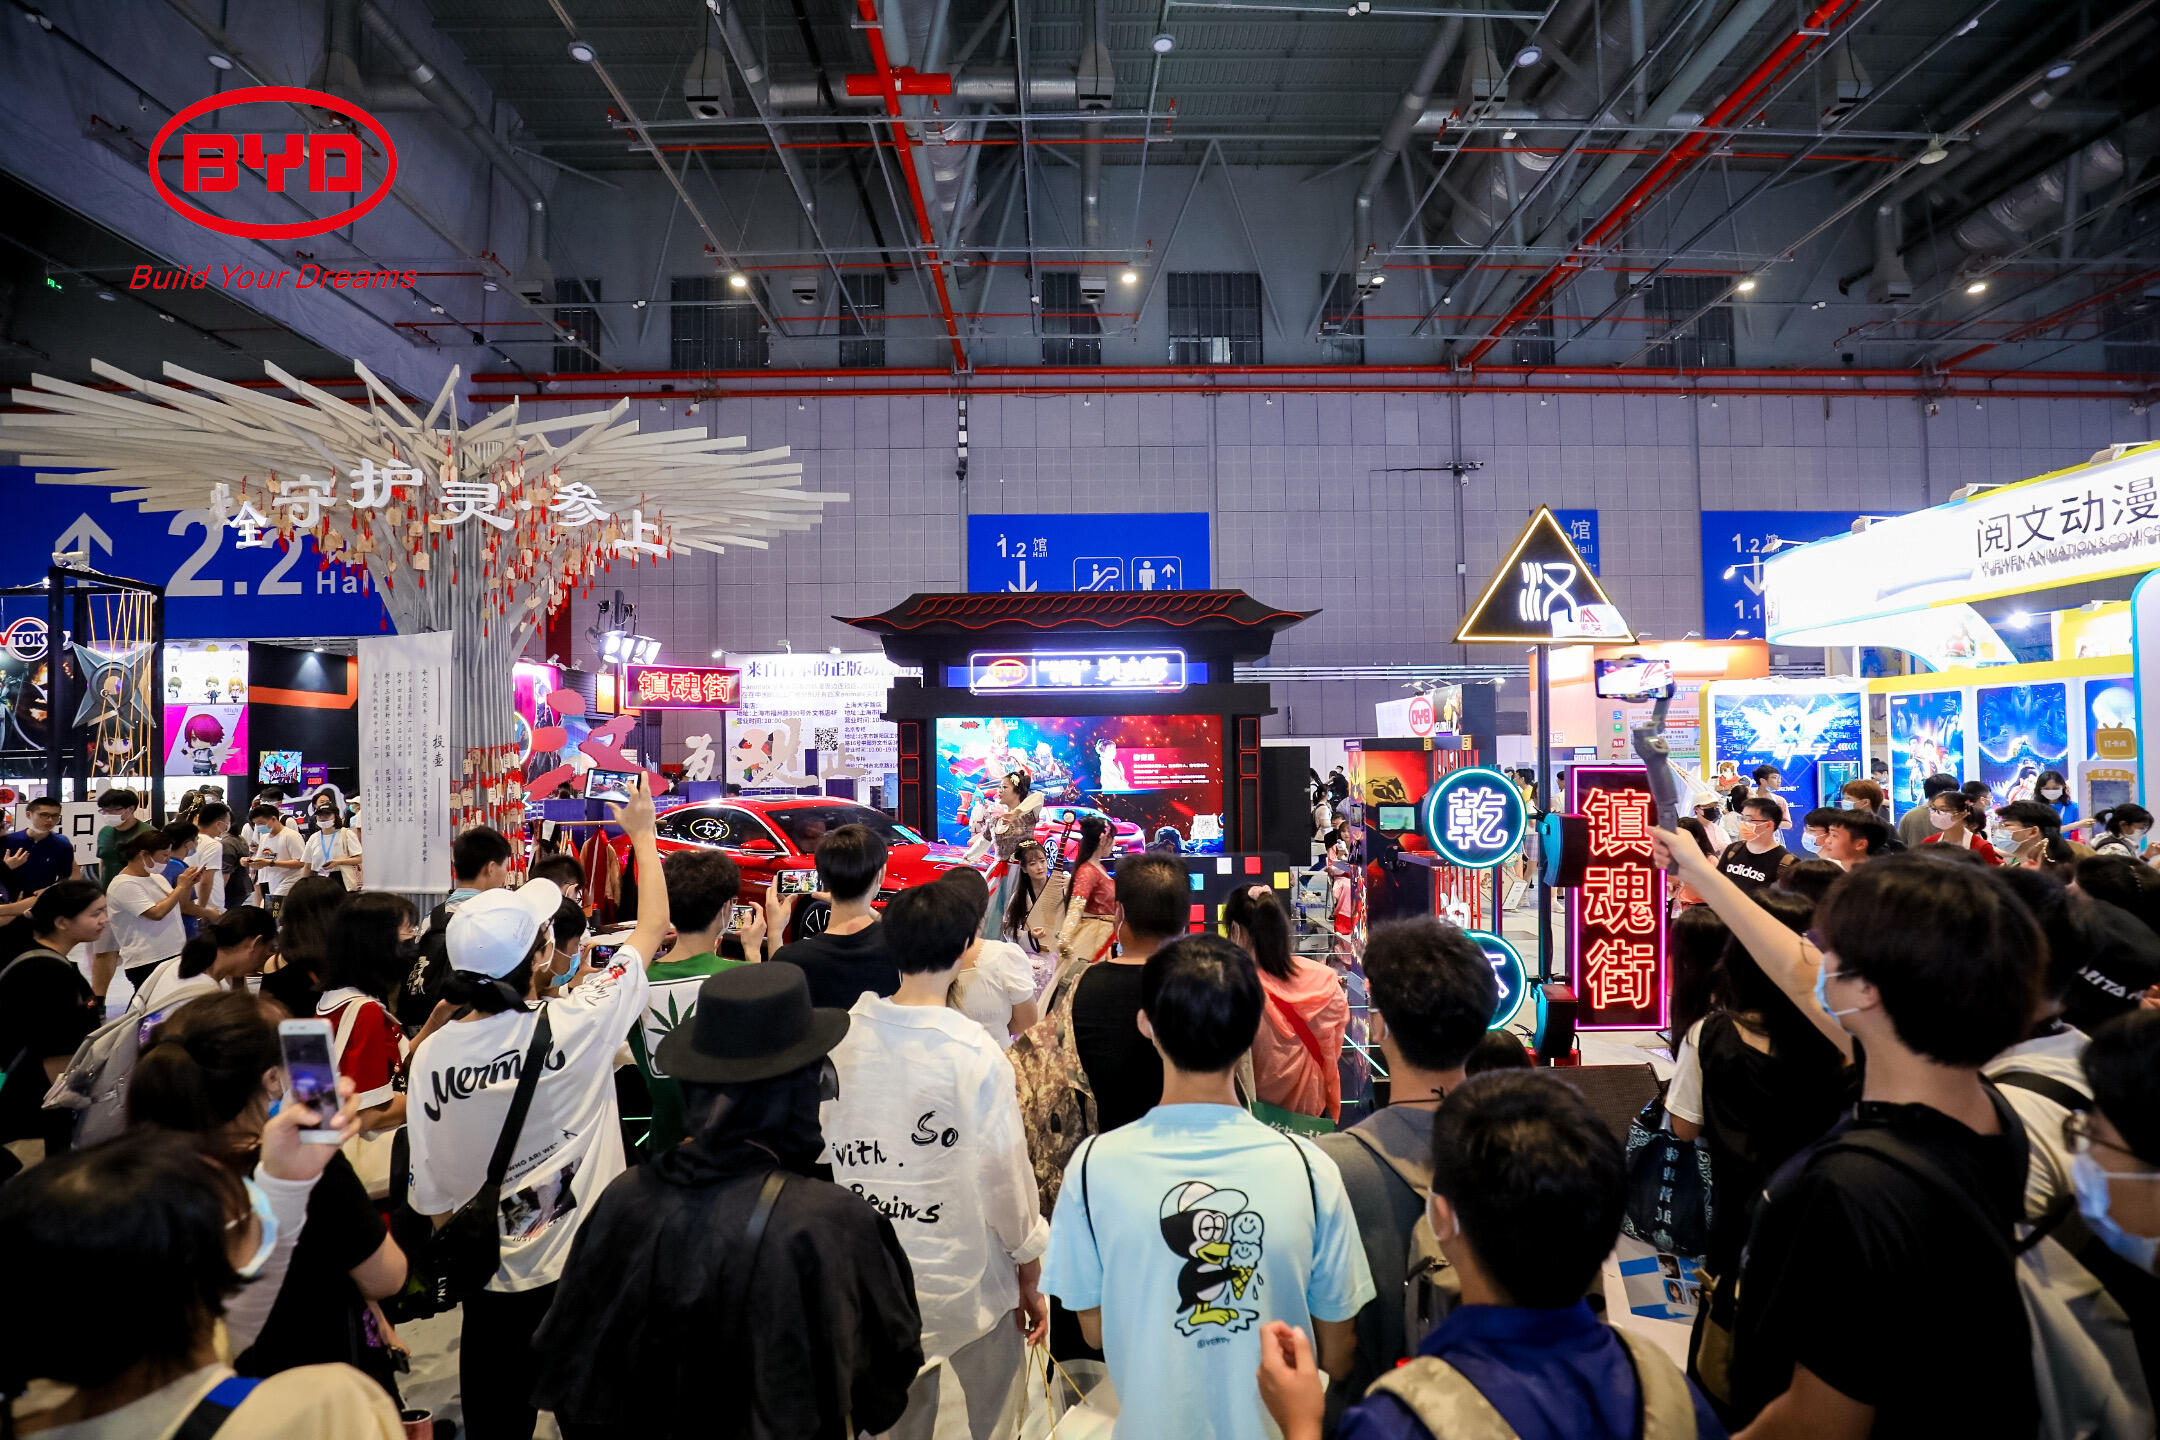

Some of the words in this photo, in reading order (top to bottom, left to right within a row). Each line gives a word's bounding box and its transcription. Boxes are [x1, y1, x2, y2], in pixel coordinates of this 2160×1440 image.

[1571, 519, 1591, 541] 馆
[1977, 476, 2160, 558] 阅文动漫
[165, 509, 303, 596] 2.2
[996, 537, 1027, 558] 1.2
[1032, 537, 1048, 552] 馆
[1732, 533, 1760, 553] 1.2
[1981, 554, 2027, 572] YUEWEN
[1734, 600, 1760, 619] 1.1
[638, 670, 731, 703] 镇魂街
[1447, 787, 1508, 850] 乾
[1726, 863, 1766, 882] adidas
[1582, 787, 1656, 1010] 镇魂街
[911, 1110, 959, 1148] So
